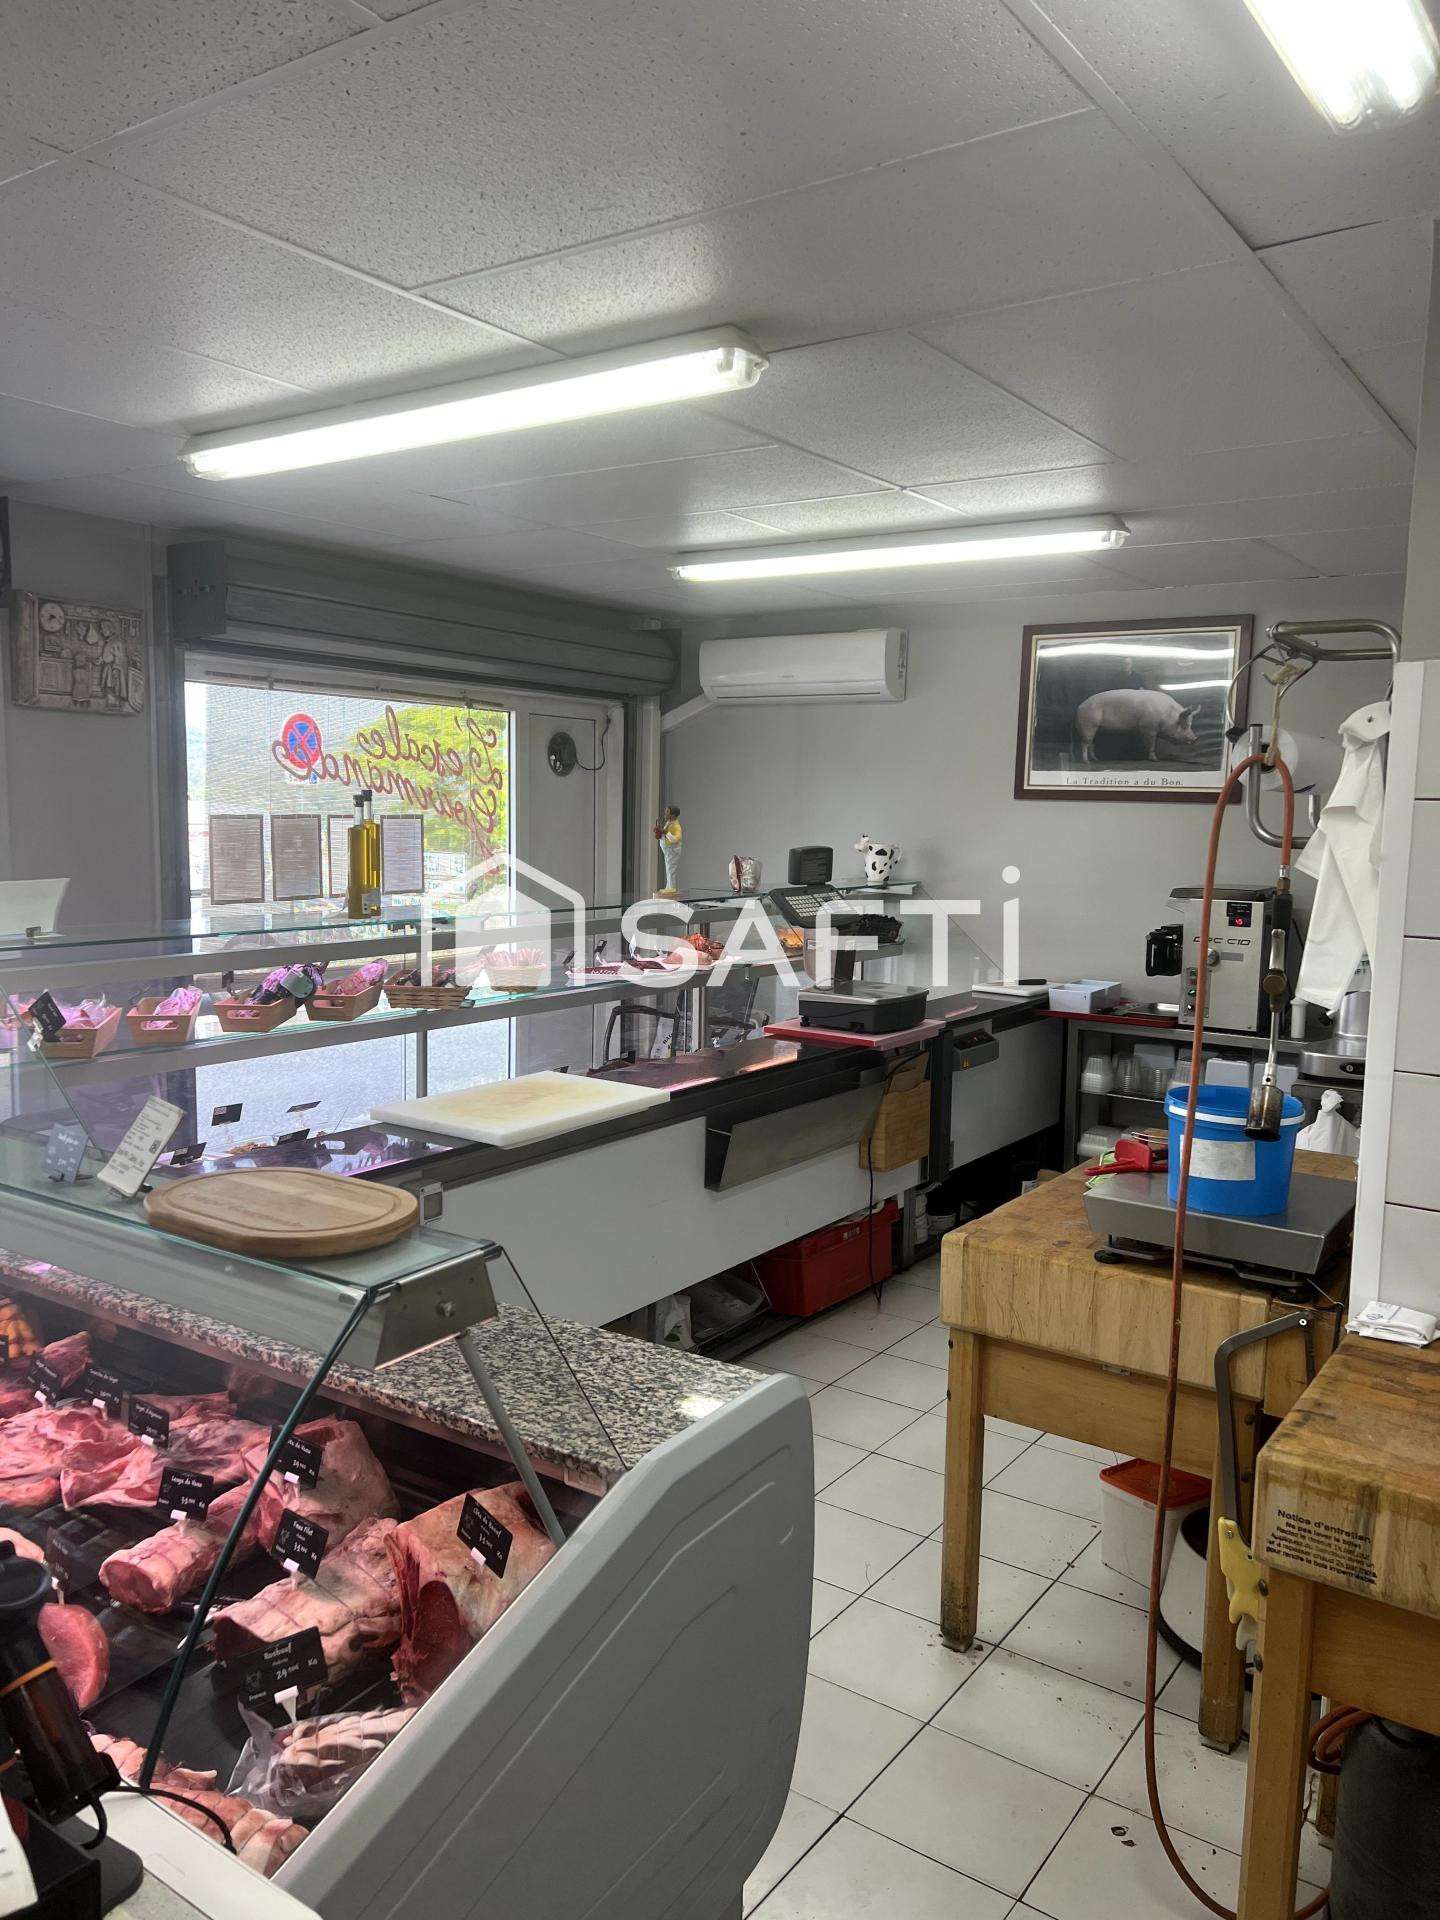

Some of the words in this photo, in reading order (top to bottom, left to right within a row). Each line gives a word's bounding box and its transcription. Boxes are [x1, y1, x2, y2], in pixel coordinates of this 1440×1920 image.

[1066, 777, 1078, 785] La
[1083, 777, 1130, 785] Tradition
[1144, 777, 1156, 786] du
[1277, 1509, 1311, 1526] Notice
[1314, 1520, 1372, 1544] d'entretien
